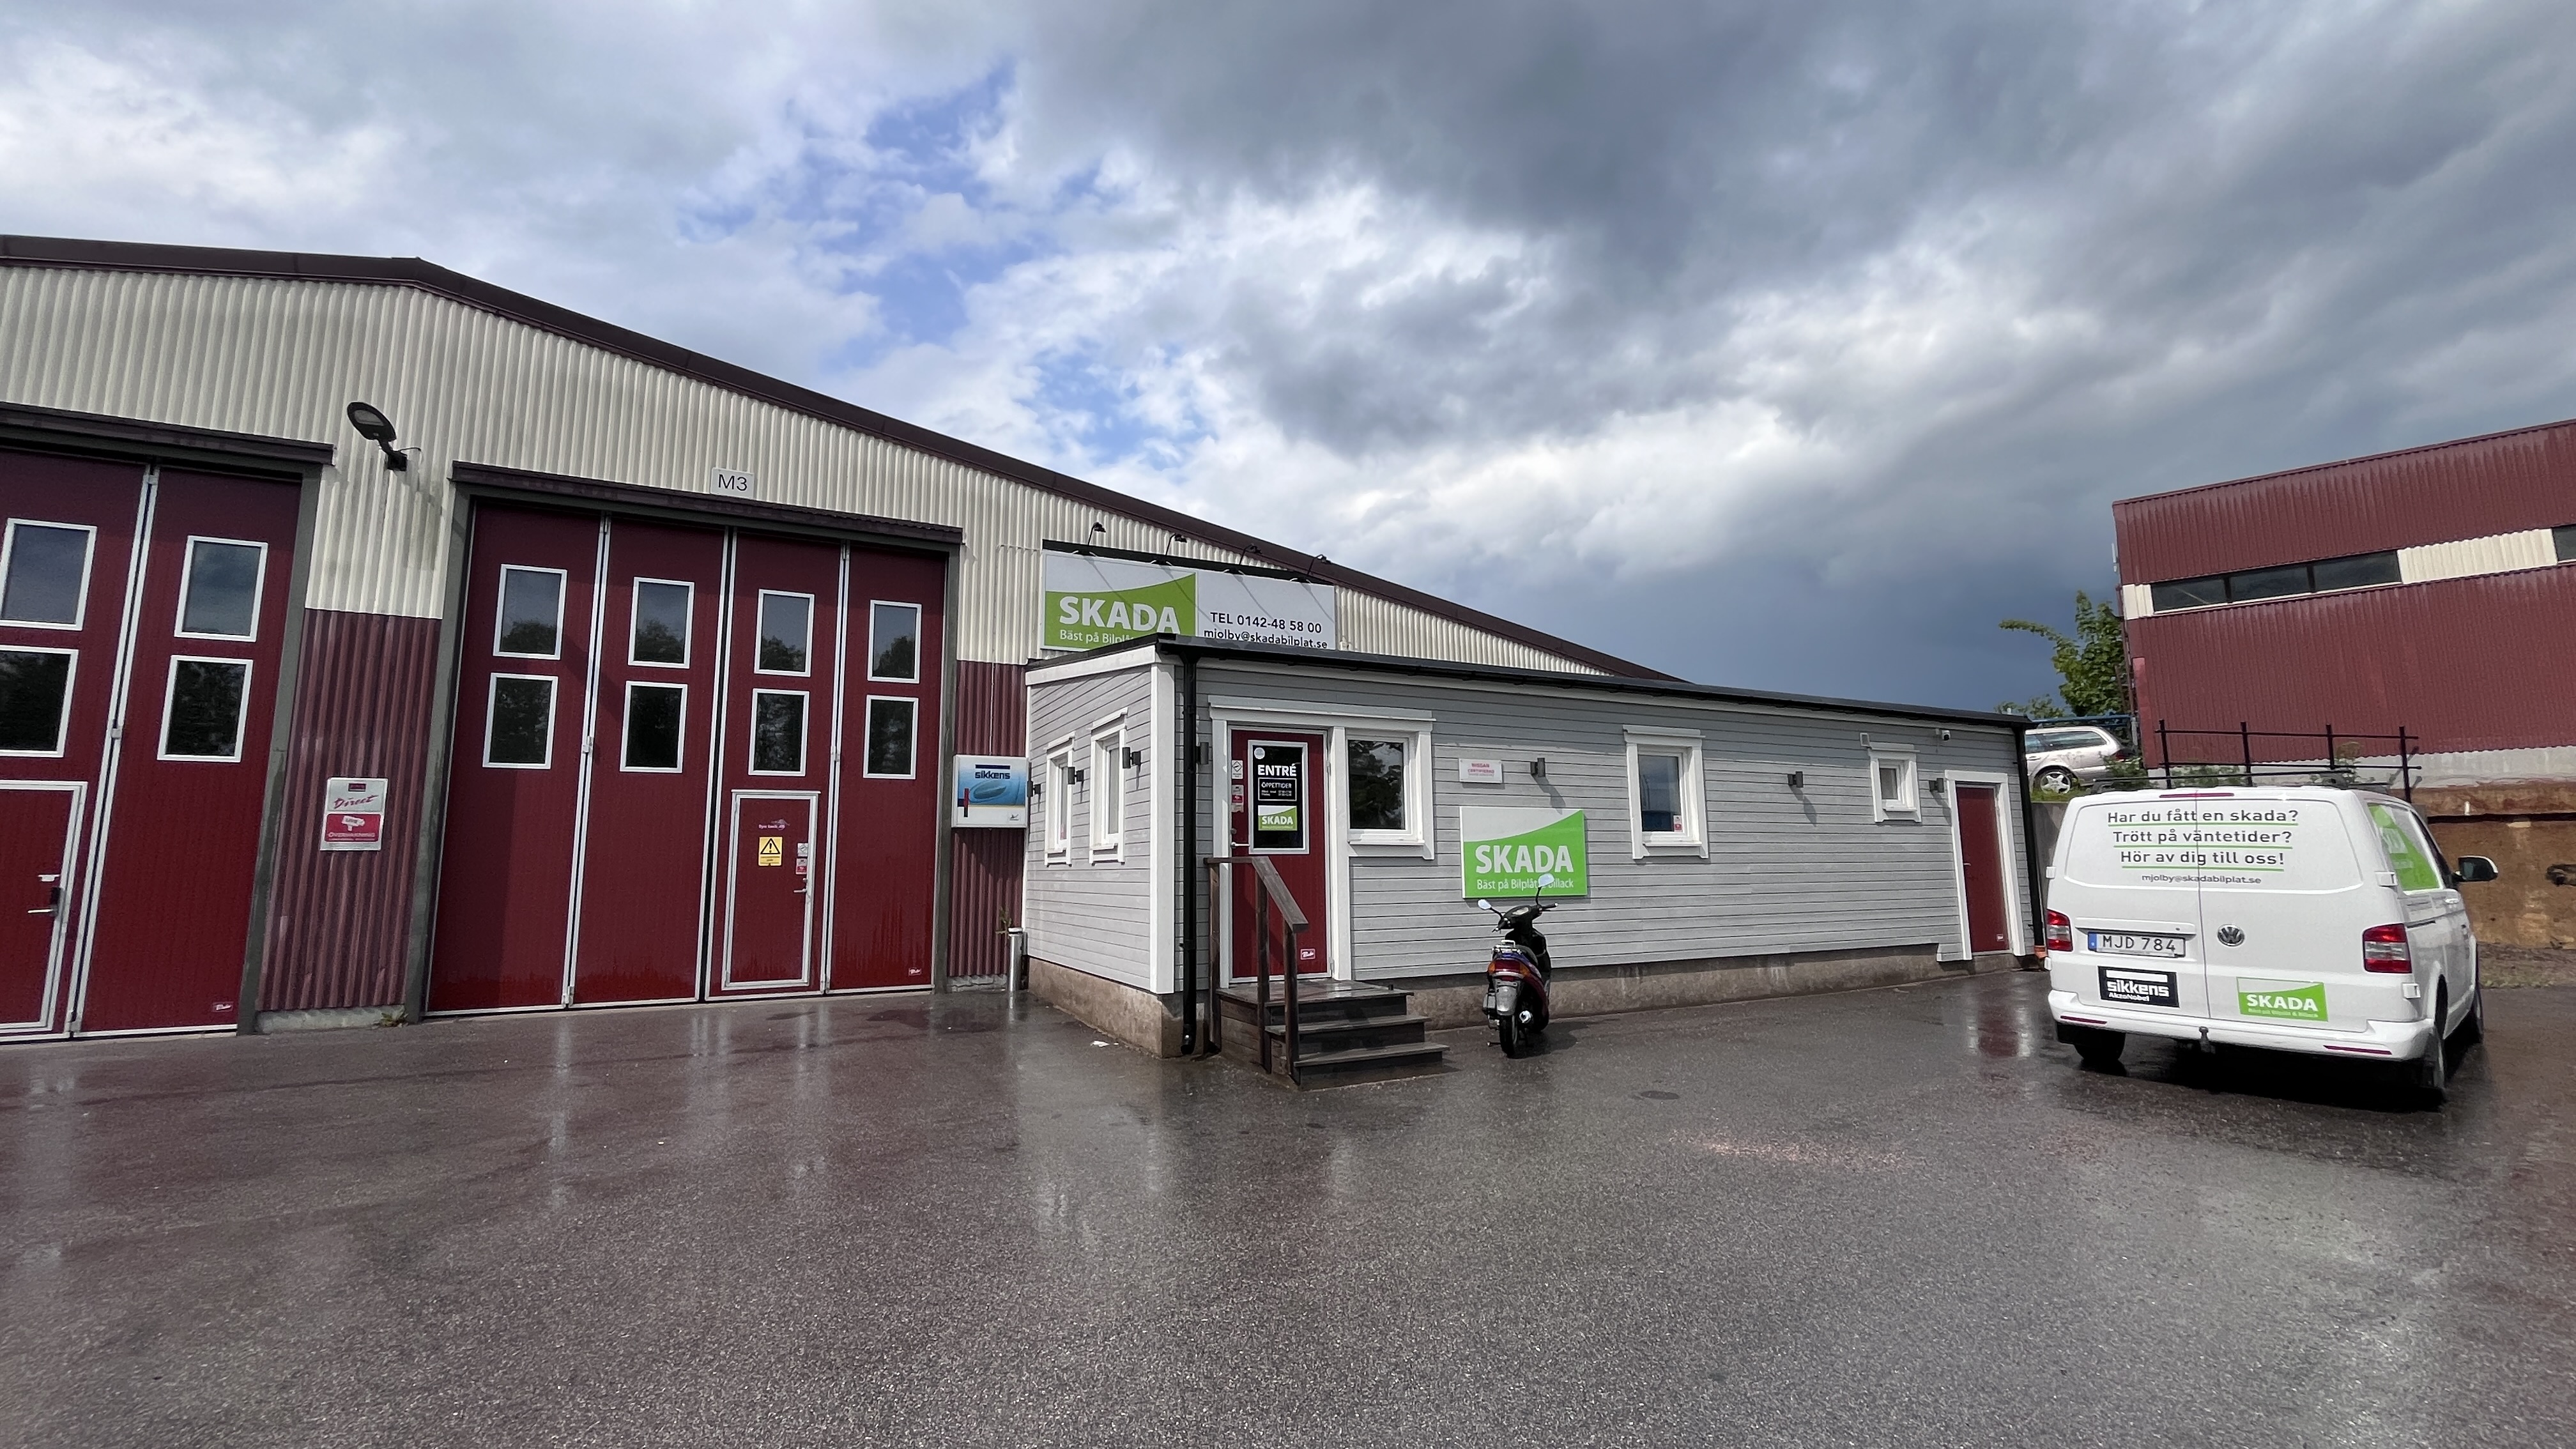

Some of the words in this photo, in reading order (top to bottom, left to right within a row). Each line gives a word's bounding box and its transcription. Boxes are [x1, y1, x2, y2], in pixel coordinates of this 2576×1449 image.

[718, 474, 747, 491] M3
[1059, 595, 1181, 634] SKADA
[1210, 611, 1233, 624] TEL
[1237, 615, 1285, 630] 0142-48
[1289, 620, 1304, 632] 58
[1307, 622, 1322, 633] 00
[1060, 629, 1083, 641] Bäst
[1085, 632, 1100, 644] på
[974, 770, 1011, 779] sikkens
[1257, 763, 1297, 777] ENTRÉ
[334, 794, 379, 809] Direct
[1261, 816, 1294, 825] SKADA
[2108, 812, 2136, 823] Har
[2141, 811, 2161, 822] du
[2166, 808, 2198, 822] fått
[2202, 812, 2224, 821] en
[2230, 809, 2299, 822] skada?
[2113, 831, 2152, 843] Trött
[2158, 829, 2177, 845] på
[2182, 830, 2292, 843] väntetider?
[1475, 845, 1574, 874] SKADA
[2120, 850, 2150, 862] Hör
[2156, 853, 2175, 862] av
[2181, 851, 2206, 866] dig
[2212, 851, 2239, 864] till
[2244, 852, 2285, 865] oss!
[1476, 879, 1496, 890] Bäst
[1498, 878, 1509, 892] på
[1511, 878, 1538, 891] Bilplåt
[2142, 874, 2262, 884] mjolby@skadabilplat.se
[2103, 935, 2135, 949] MJD
[2141, 937, 2176, 952] 784
[2106, 979, 2170, 997] sikkens
[2108, 992, 2150, 1002] AkzoNobel
[2246, 993, 2319, 1012] SKADA
